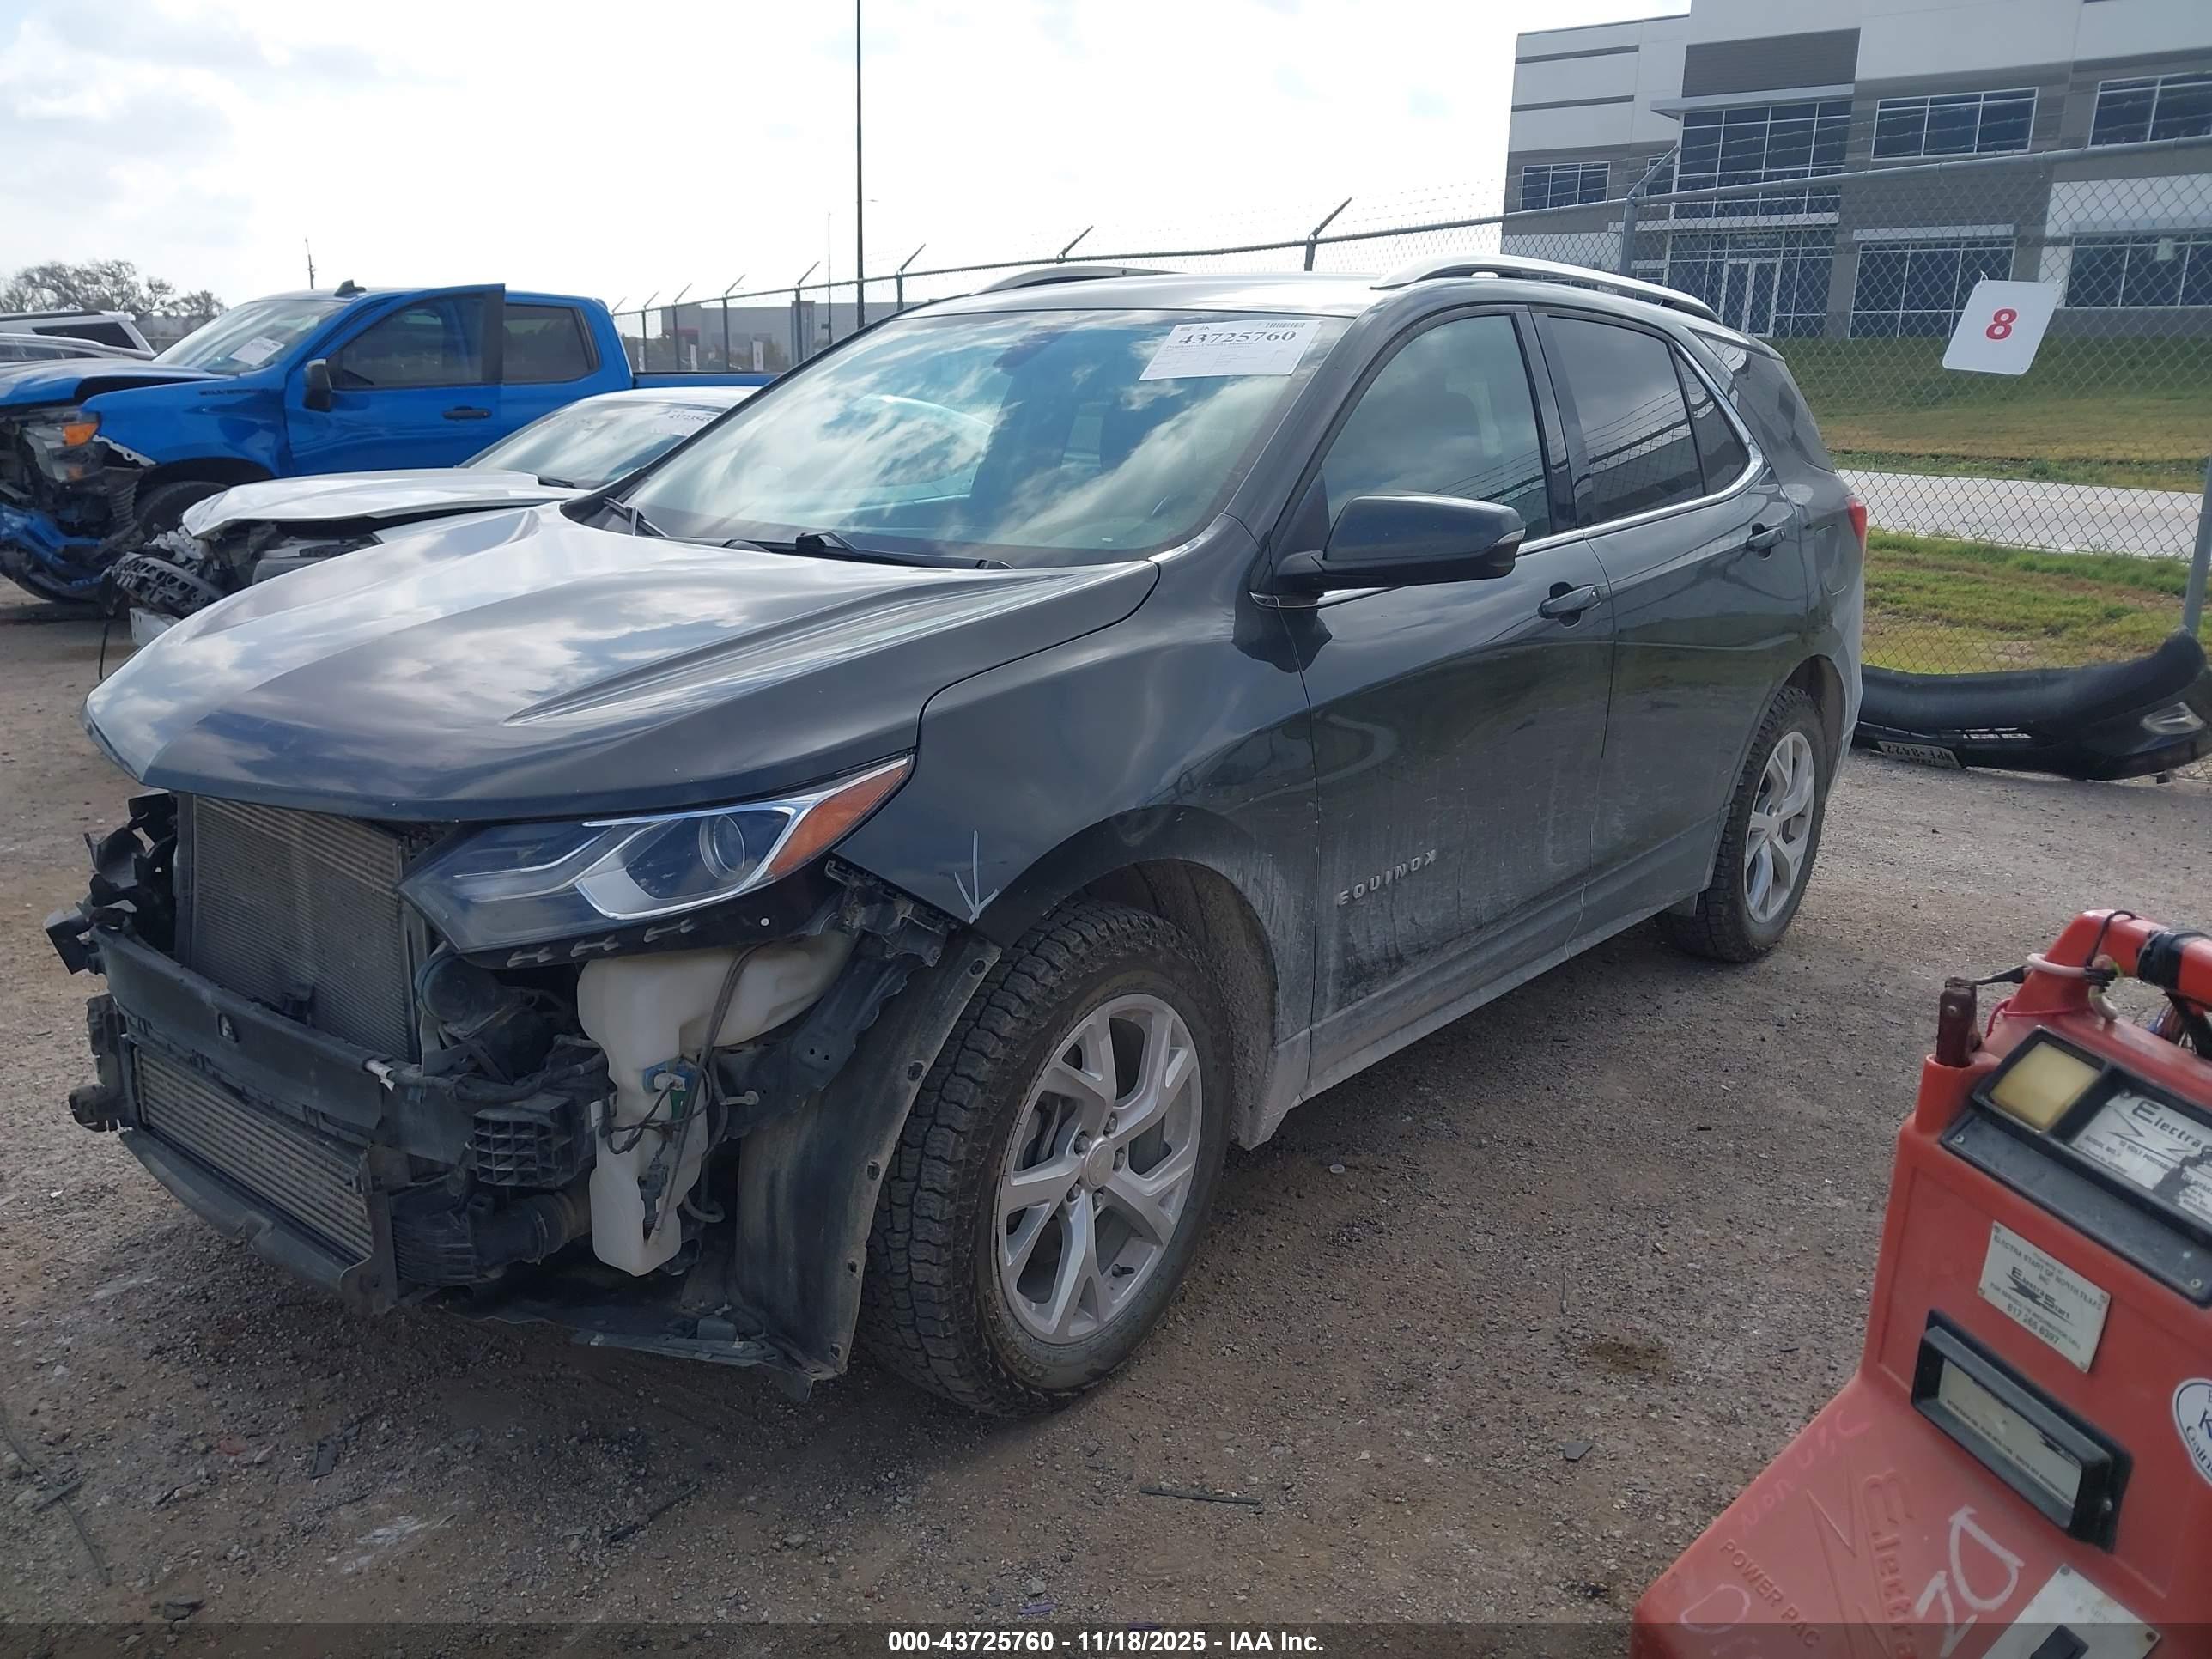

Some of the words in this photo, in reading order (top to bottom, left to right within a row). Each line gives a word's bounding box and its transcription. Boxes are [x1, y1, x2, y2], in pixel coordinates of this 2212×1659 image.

[1179, 331, 1297, 343] 43725760
[1985, 307, 2018, 341] 8
[1338, 849, 1437, 907] EQUINOX
[1719, 1538, 1784, 1608] POWER
[1780, 1602, 1822, 1649] PAC
